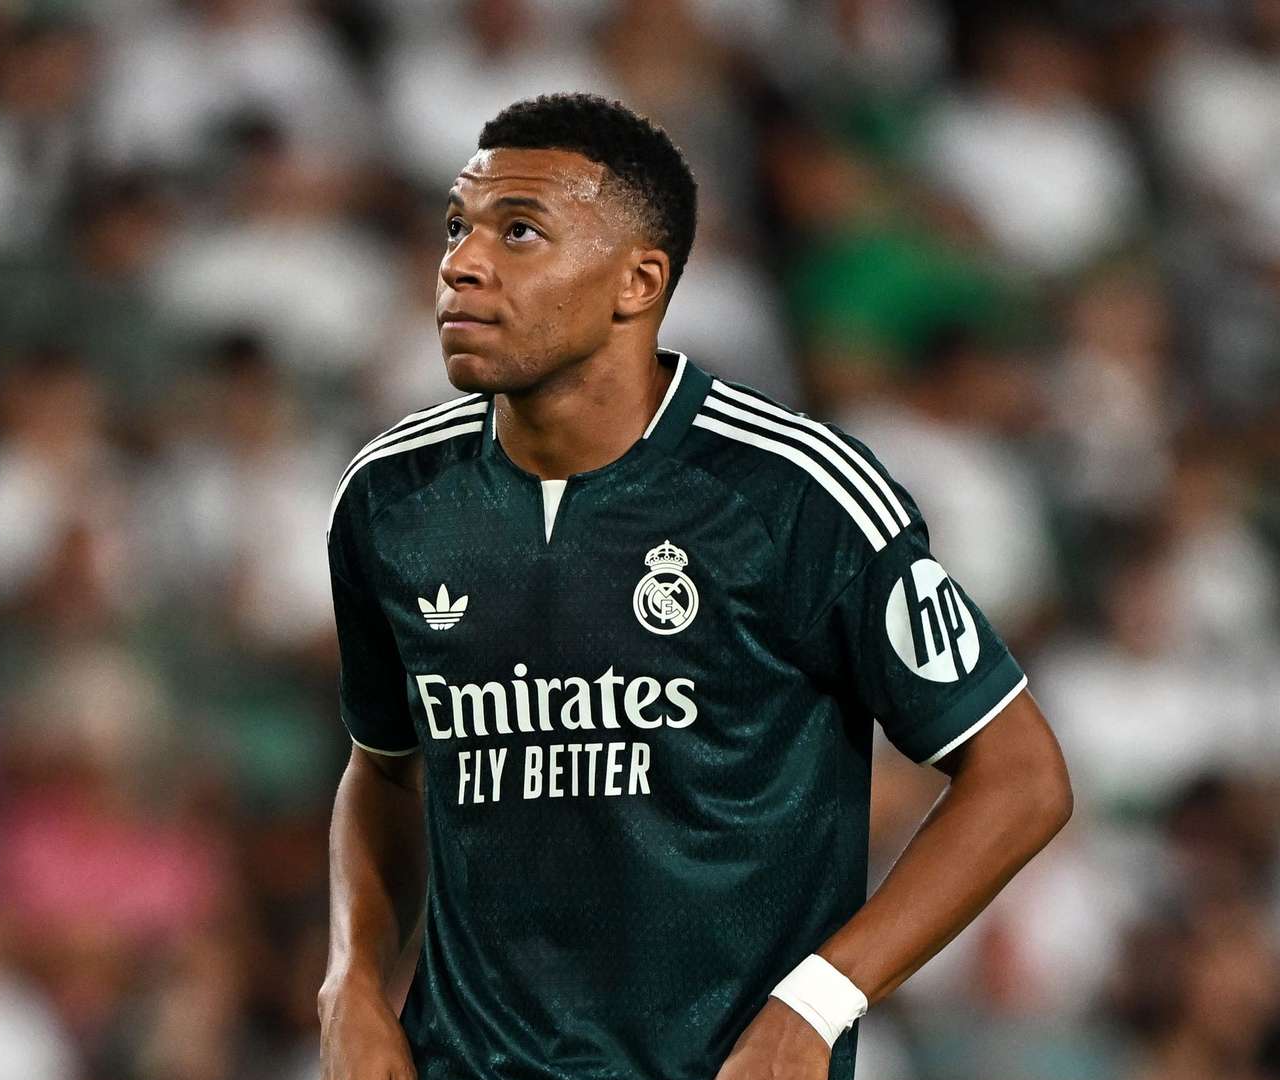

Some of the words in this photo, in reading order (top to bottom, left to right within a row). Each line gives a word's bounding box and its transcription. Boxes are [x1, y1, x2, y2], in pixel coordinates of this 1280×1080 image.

[900, 564, 968, 680] hp
[415, 663, 699, 740] Emirates
[458, 746, 508, 805] FLY
[523, 742, 652, 800] BETTER
